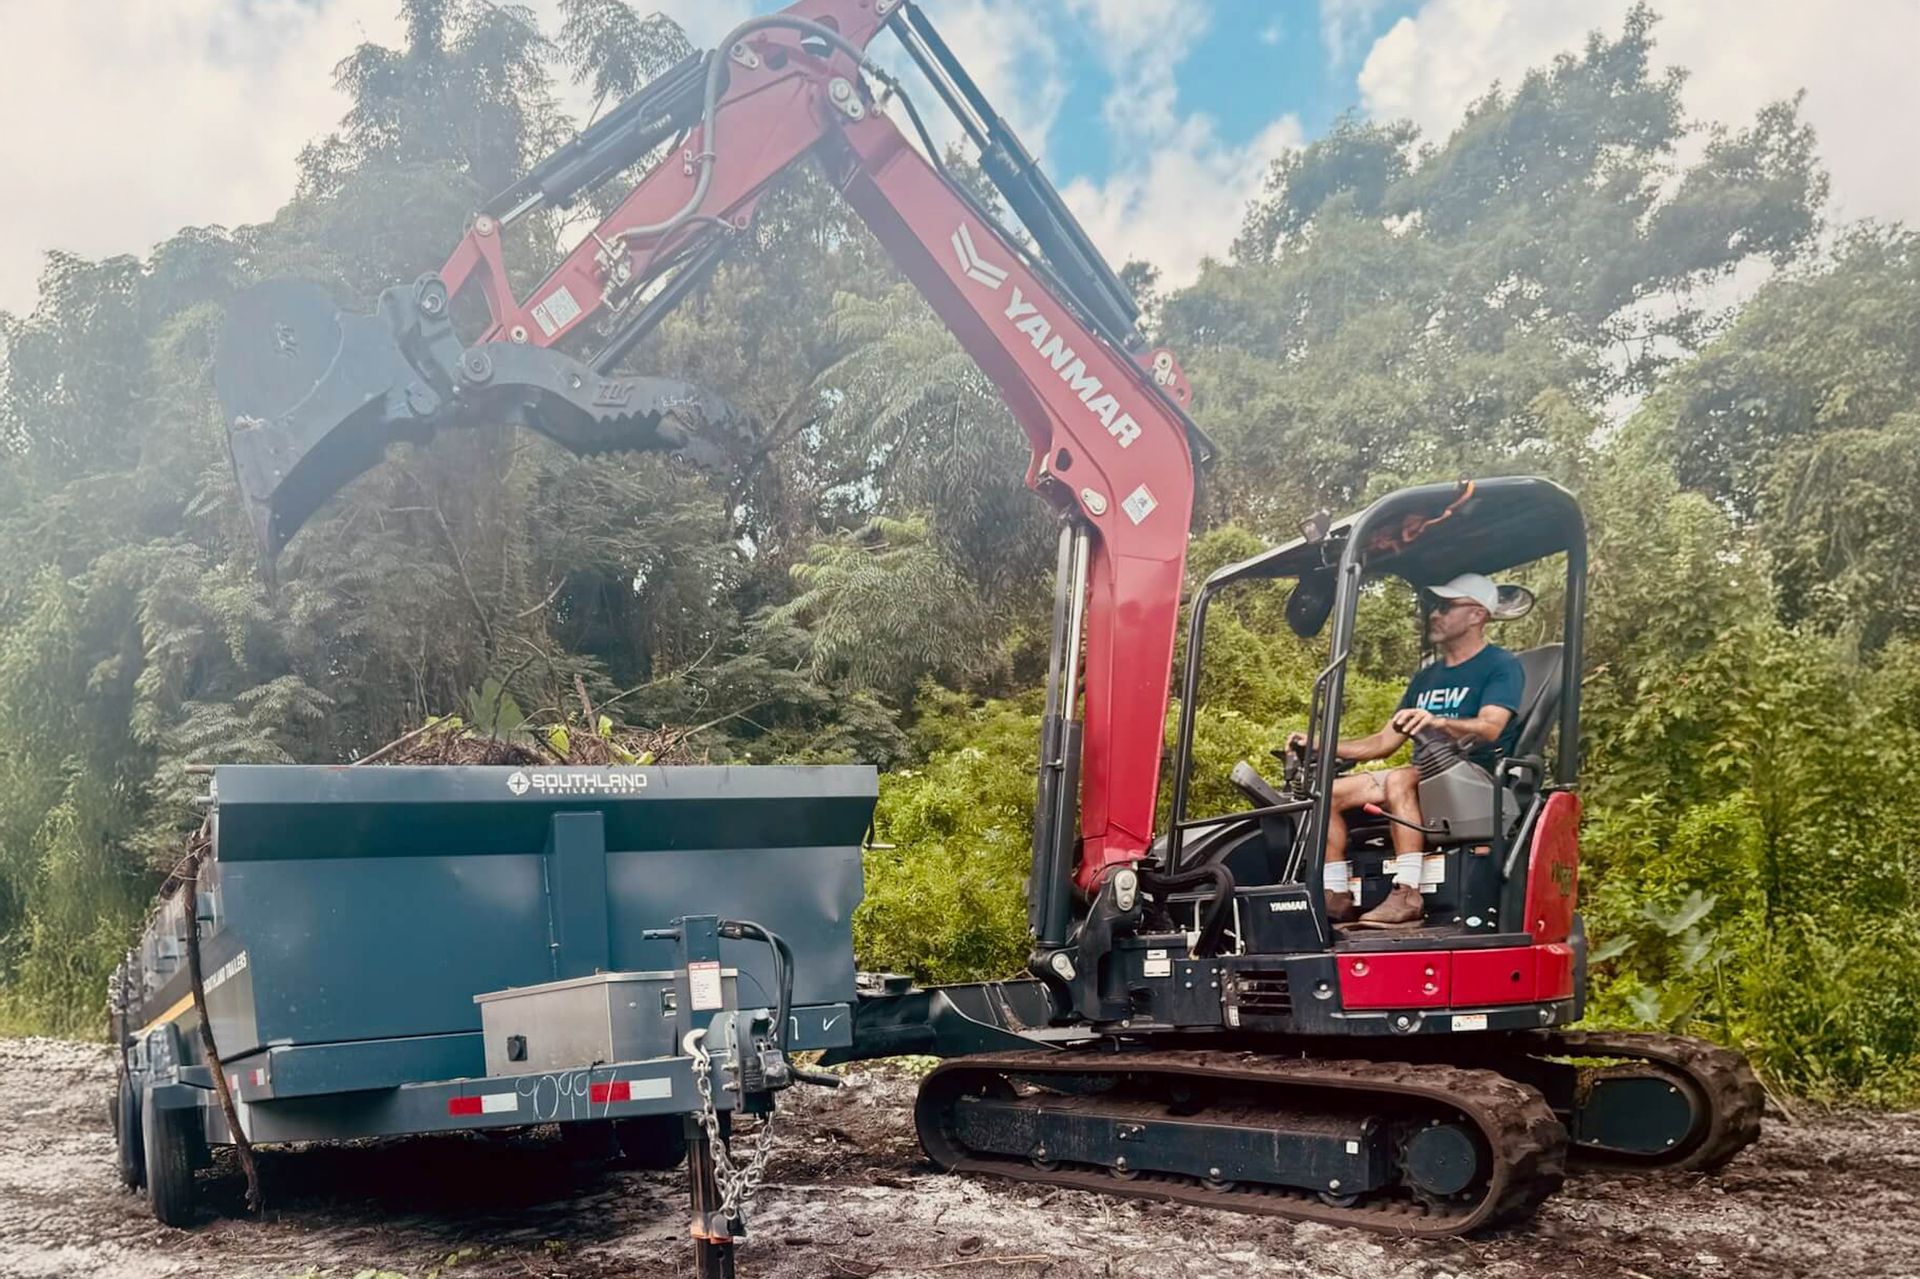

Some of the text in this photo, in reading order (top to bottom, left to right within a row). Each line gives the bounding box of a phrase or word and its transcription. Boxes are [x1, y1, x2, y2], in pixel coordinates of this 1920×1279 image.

[1004, 285, 1142, 449] YANMAR
[1416, 686, 1470, 710] NEW
[532, 774, 647, 788] SOUTHLAND
[1269, 900, 1308, 912] YANMAR
